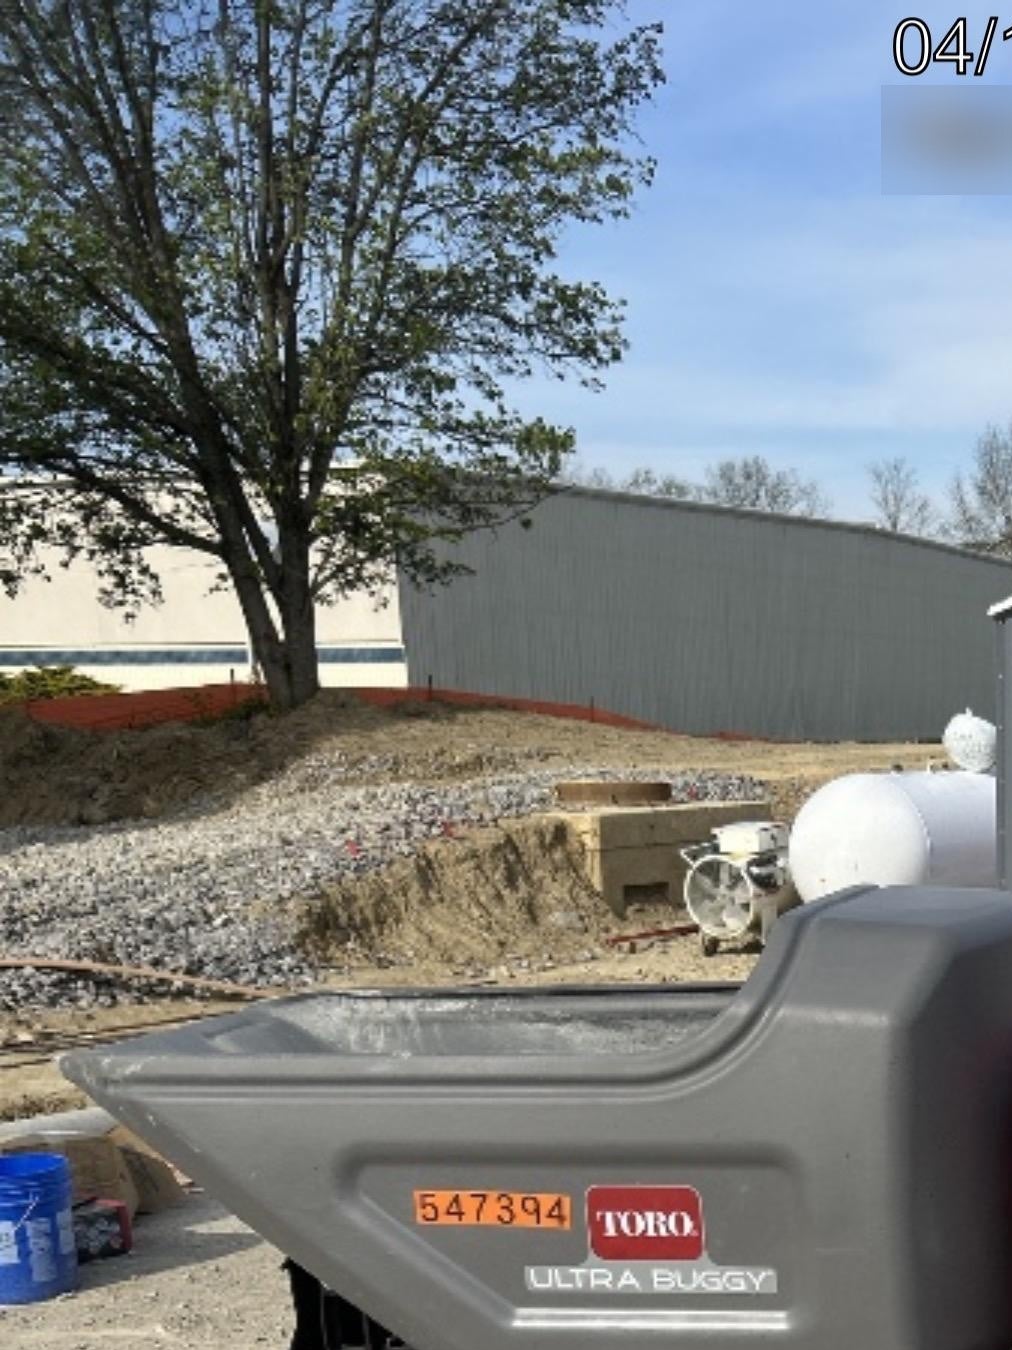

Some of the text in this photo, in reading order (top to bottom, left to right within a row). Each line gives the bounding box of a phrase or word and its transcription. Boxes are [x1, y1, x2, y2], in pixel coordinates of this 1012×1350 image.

[420, 1193, 567, 1226] 547394
[596, 1210, 694, 1237] TORO
[529, 1268, 769, 1291] ULTRA BUGGY
